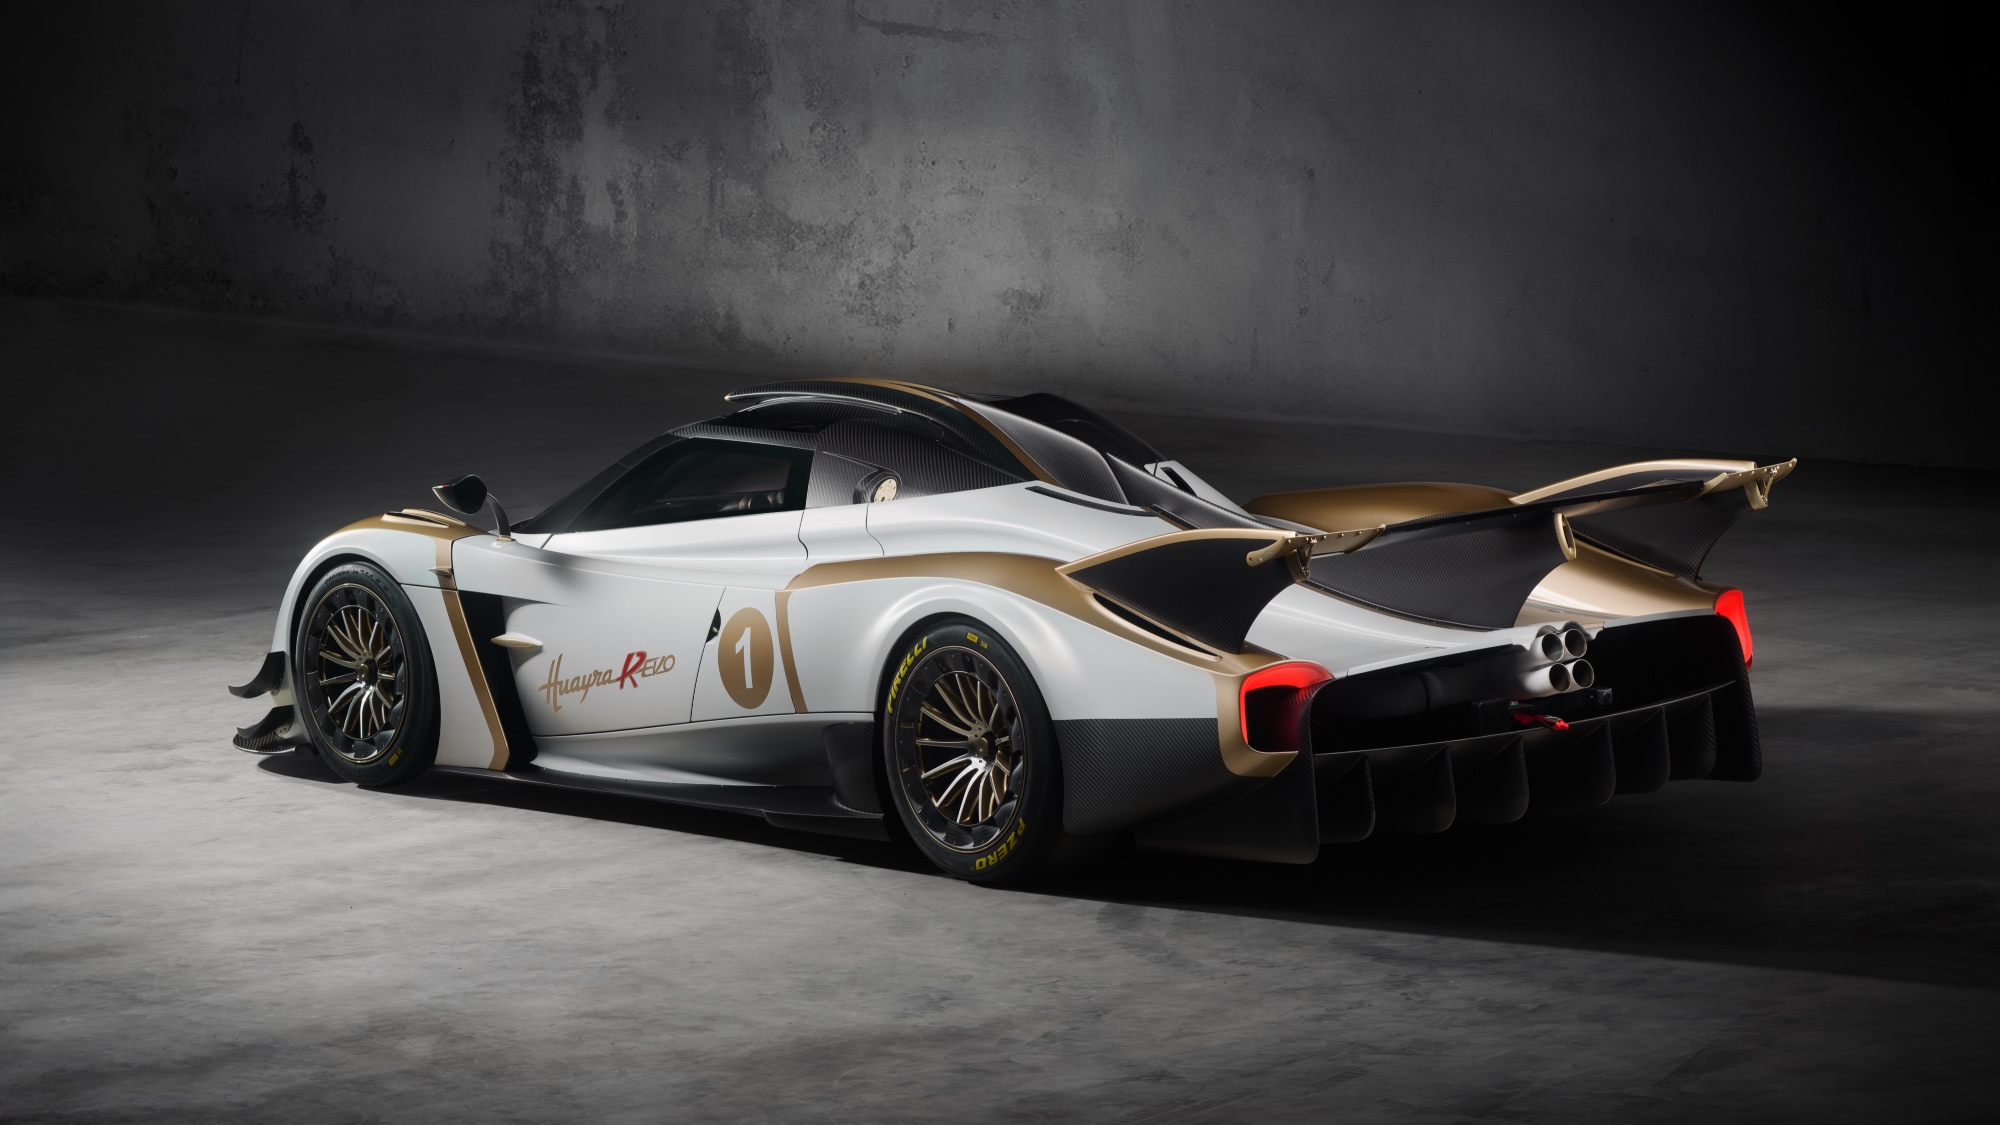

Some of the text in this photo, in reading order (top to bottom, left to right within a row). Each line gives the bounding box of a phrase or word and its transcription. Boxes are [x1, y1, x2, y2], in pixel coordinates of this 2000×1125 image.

[538, 653, 617, 714] Huayra
[735, 627, 753, 689] 1
[887, 636, 928, 714] PIRELLI
